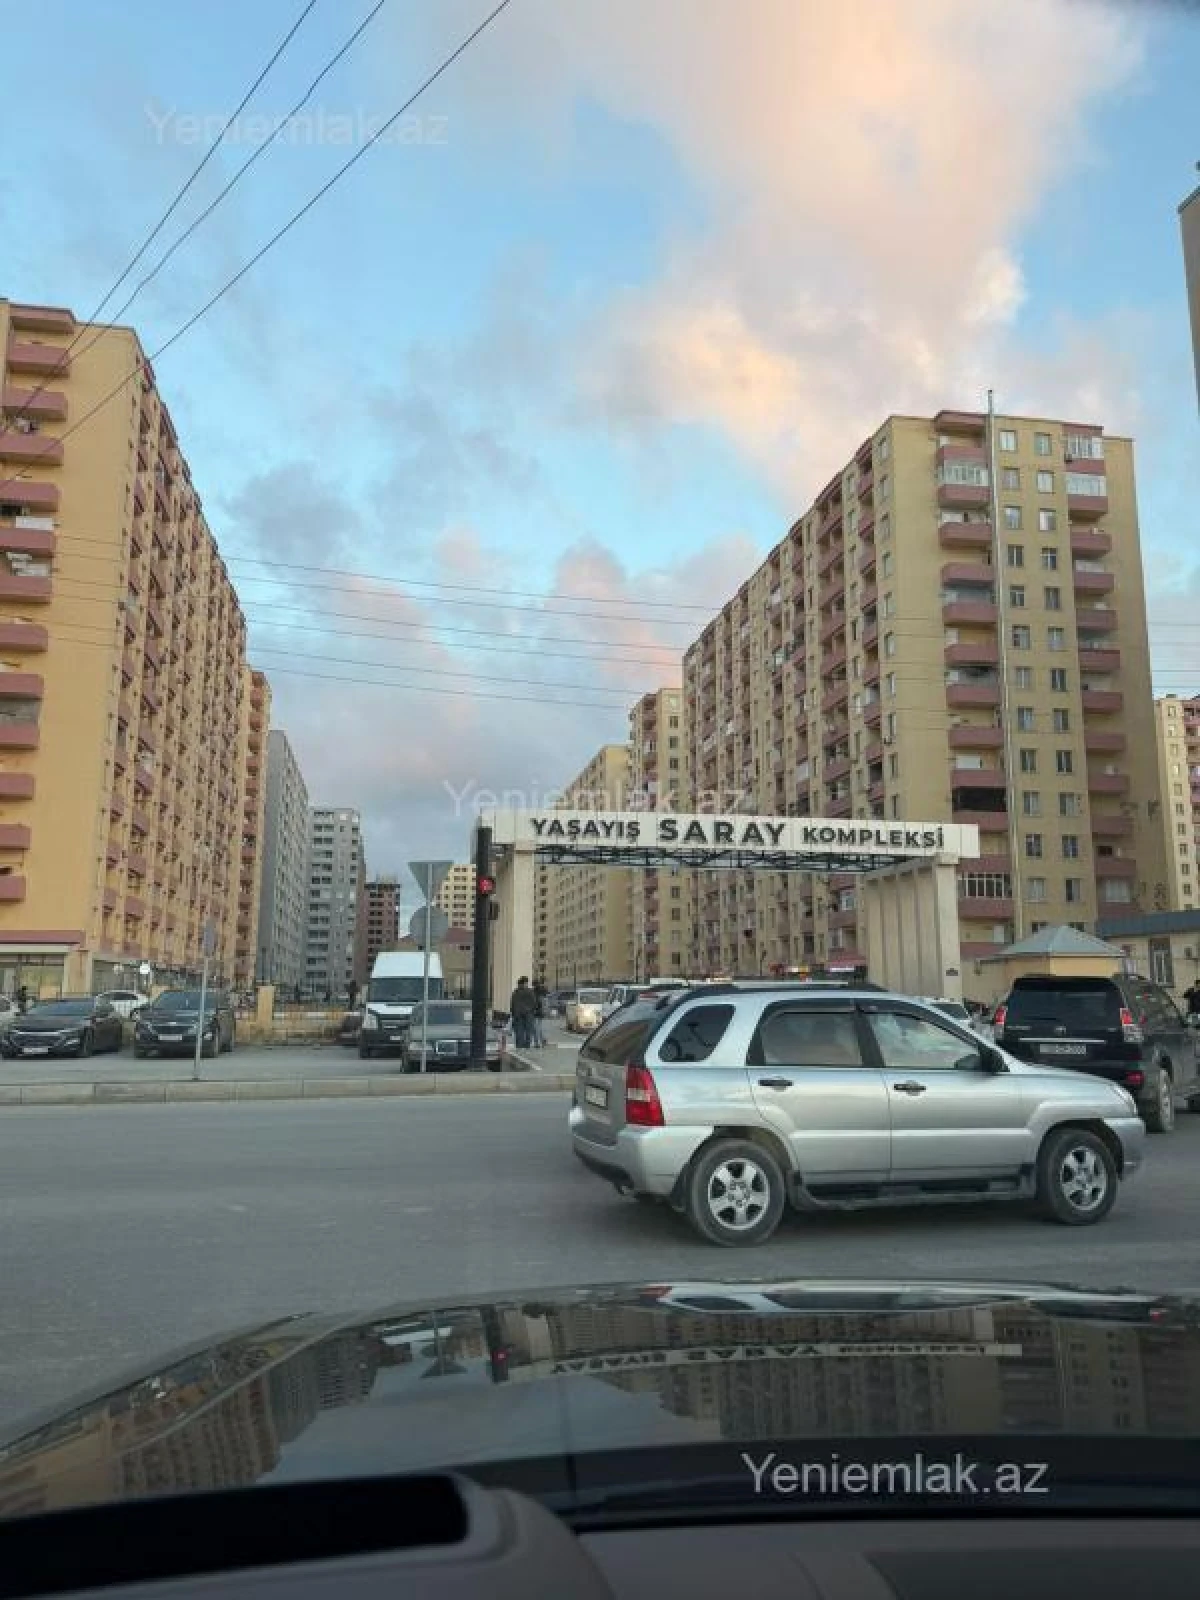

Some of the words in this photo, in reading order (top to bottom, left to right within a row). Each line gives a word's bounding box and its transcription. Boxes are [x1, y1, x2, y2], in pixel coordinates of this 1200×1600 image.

[530, 817, 641, 843] YAŞAYIŞ
[659, 818, 786, 845] SARAY
[802, 825, 945, 849] KOMPLEKSİ
